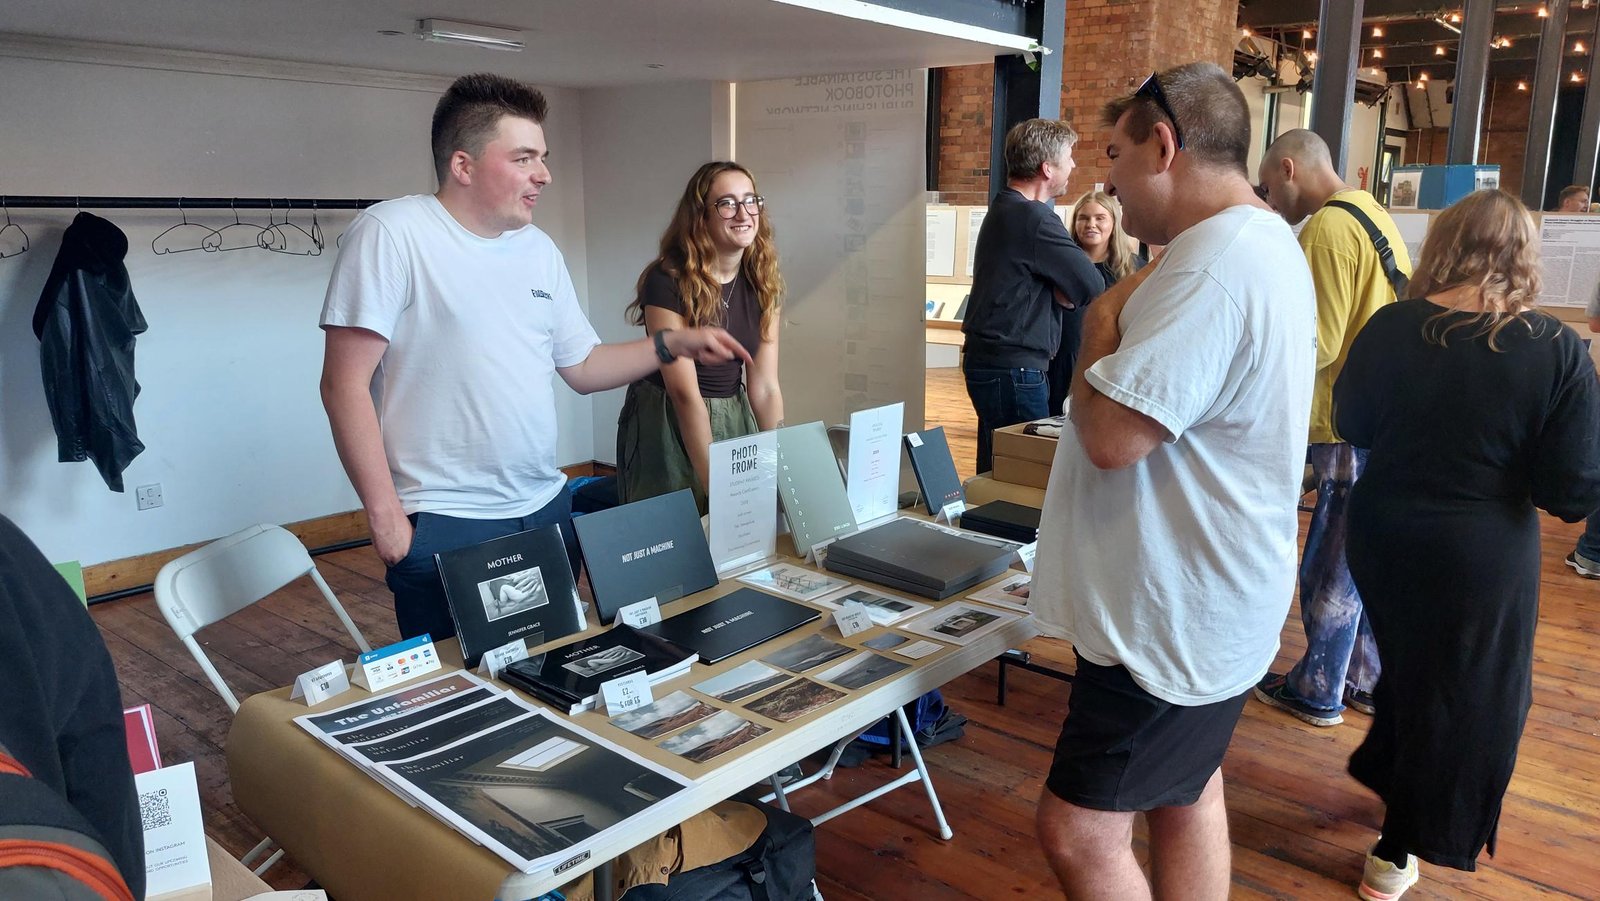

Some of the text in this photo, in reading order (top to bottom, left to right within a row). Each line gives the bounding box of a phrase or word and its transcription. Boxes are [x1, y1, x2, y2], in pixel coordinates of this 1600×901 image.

[731, 444, 758, 462] PHOTO
[731, 458, 758, 475] FROME
[621, 540, 674, 563] NOT JUST A MACHINE
[487, 553, 524, 570] MOTHER
[508, 621, 541, 637] JENNIFER GRACE
[564, 645, 600, 659] MOTHER
[334, 713, 369, 726] The
[370, 684, 457, 715] Unfamiliar
[372, 736, 430, 755] unfamiliar
[406, 755, 464, 774] unfamiliar
[155, 841, 186, 852] INSTAGRAM
